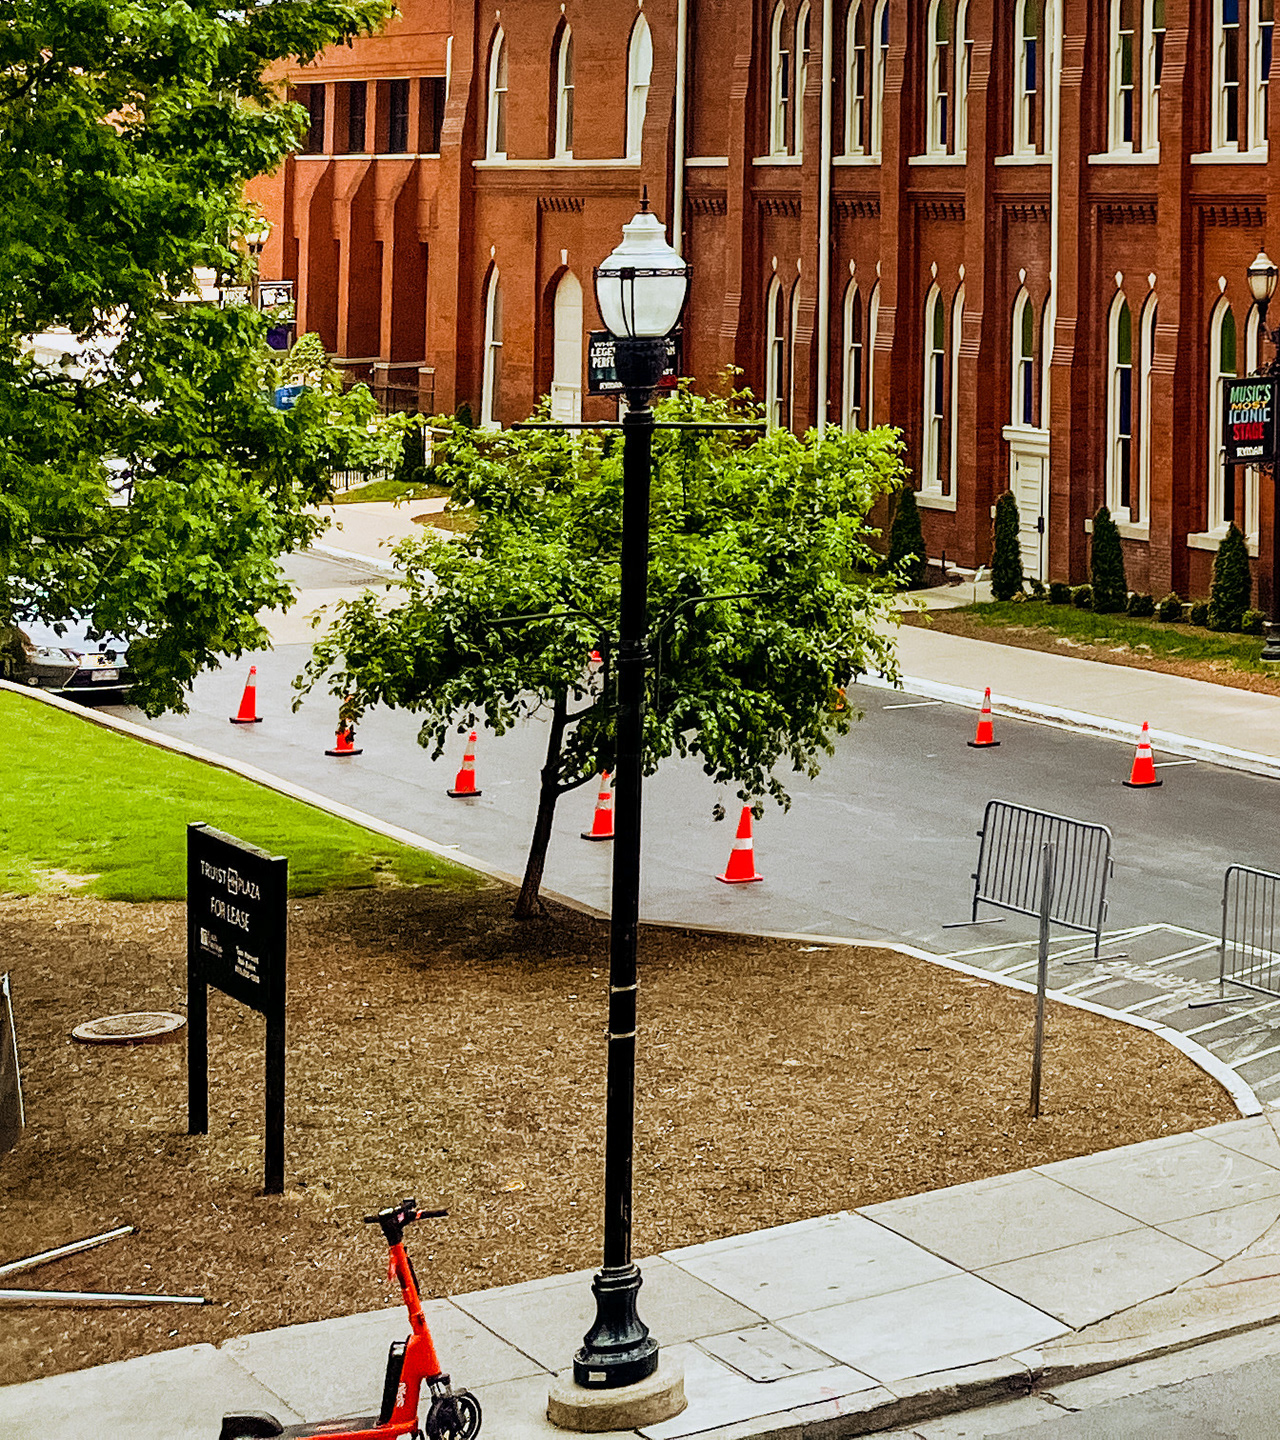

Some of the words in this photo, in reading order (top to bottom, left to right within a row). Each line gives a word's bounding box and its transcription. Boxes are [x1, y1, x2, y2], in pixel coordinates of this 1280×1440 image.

[1230, 384, 1272, 404] MUSIC'S
[1231, 400, 1267, 410] MOST
[1228, 407, 1271, 425] ICONIC
[1233, 422, 1265, 441] STAGE
[200, 859, 226, 885] TRUIST
[238, 877, 261, 901] PLAZA
[210, 896, 226, 920] FOR
[227, 904, 251, 932] LEASE
